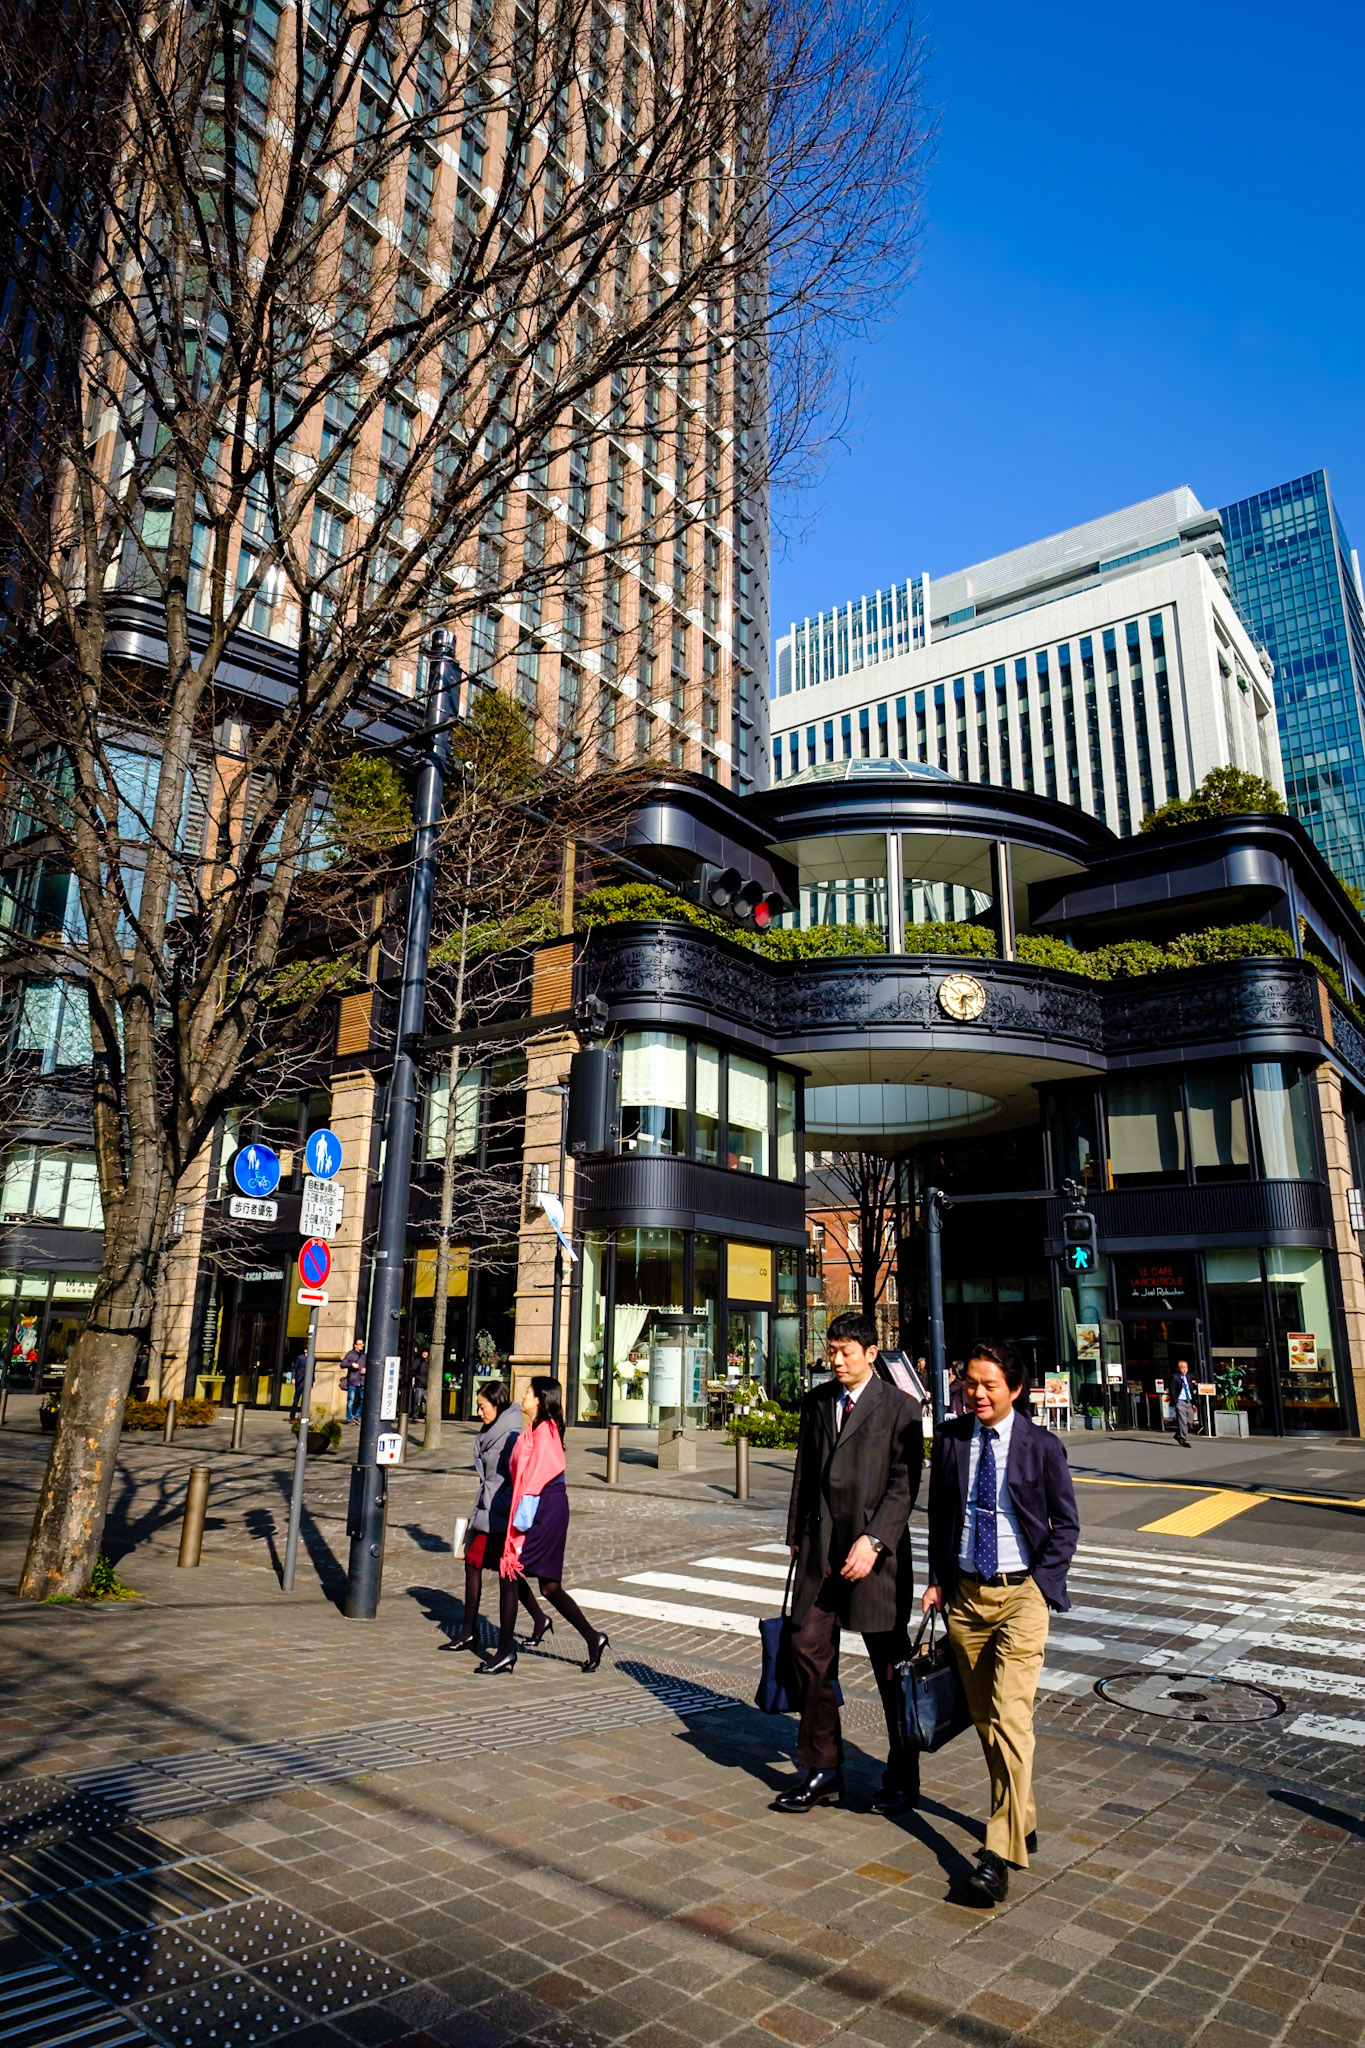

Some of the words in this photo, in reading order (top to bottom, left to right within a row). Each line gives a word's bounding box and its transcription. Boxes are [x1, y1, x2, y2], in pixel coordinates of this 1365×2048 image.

[235, 1202, 272, 1216] 歩行者優先
[307, 1203, 333, 1216] 11-15
[305, 1224, 331, 1236] 11-17
